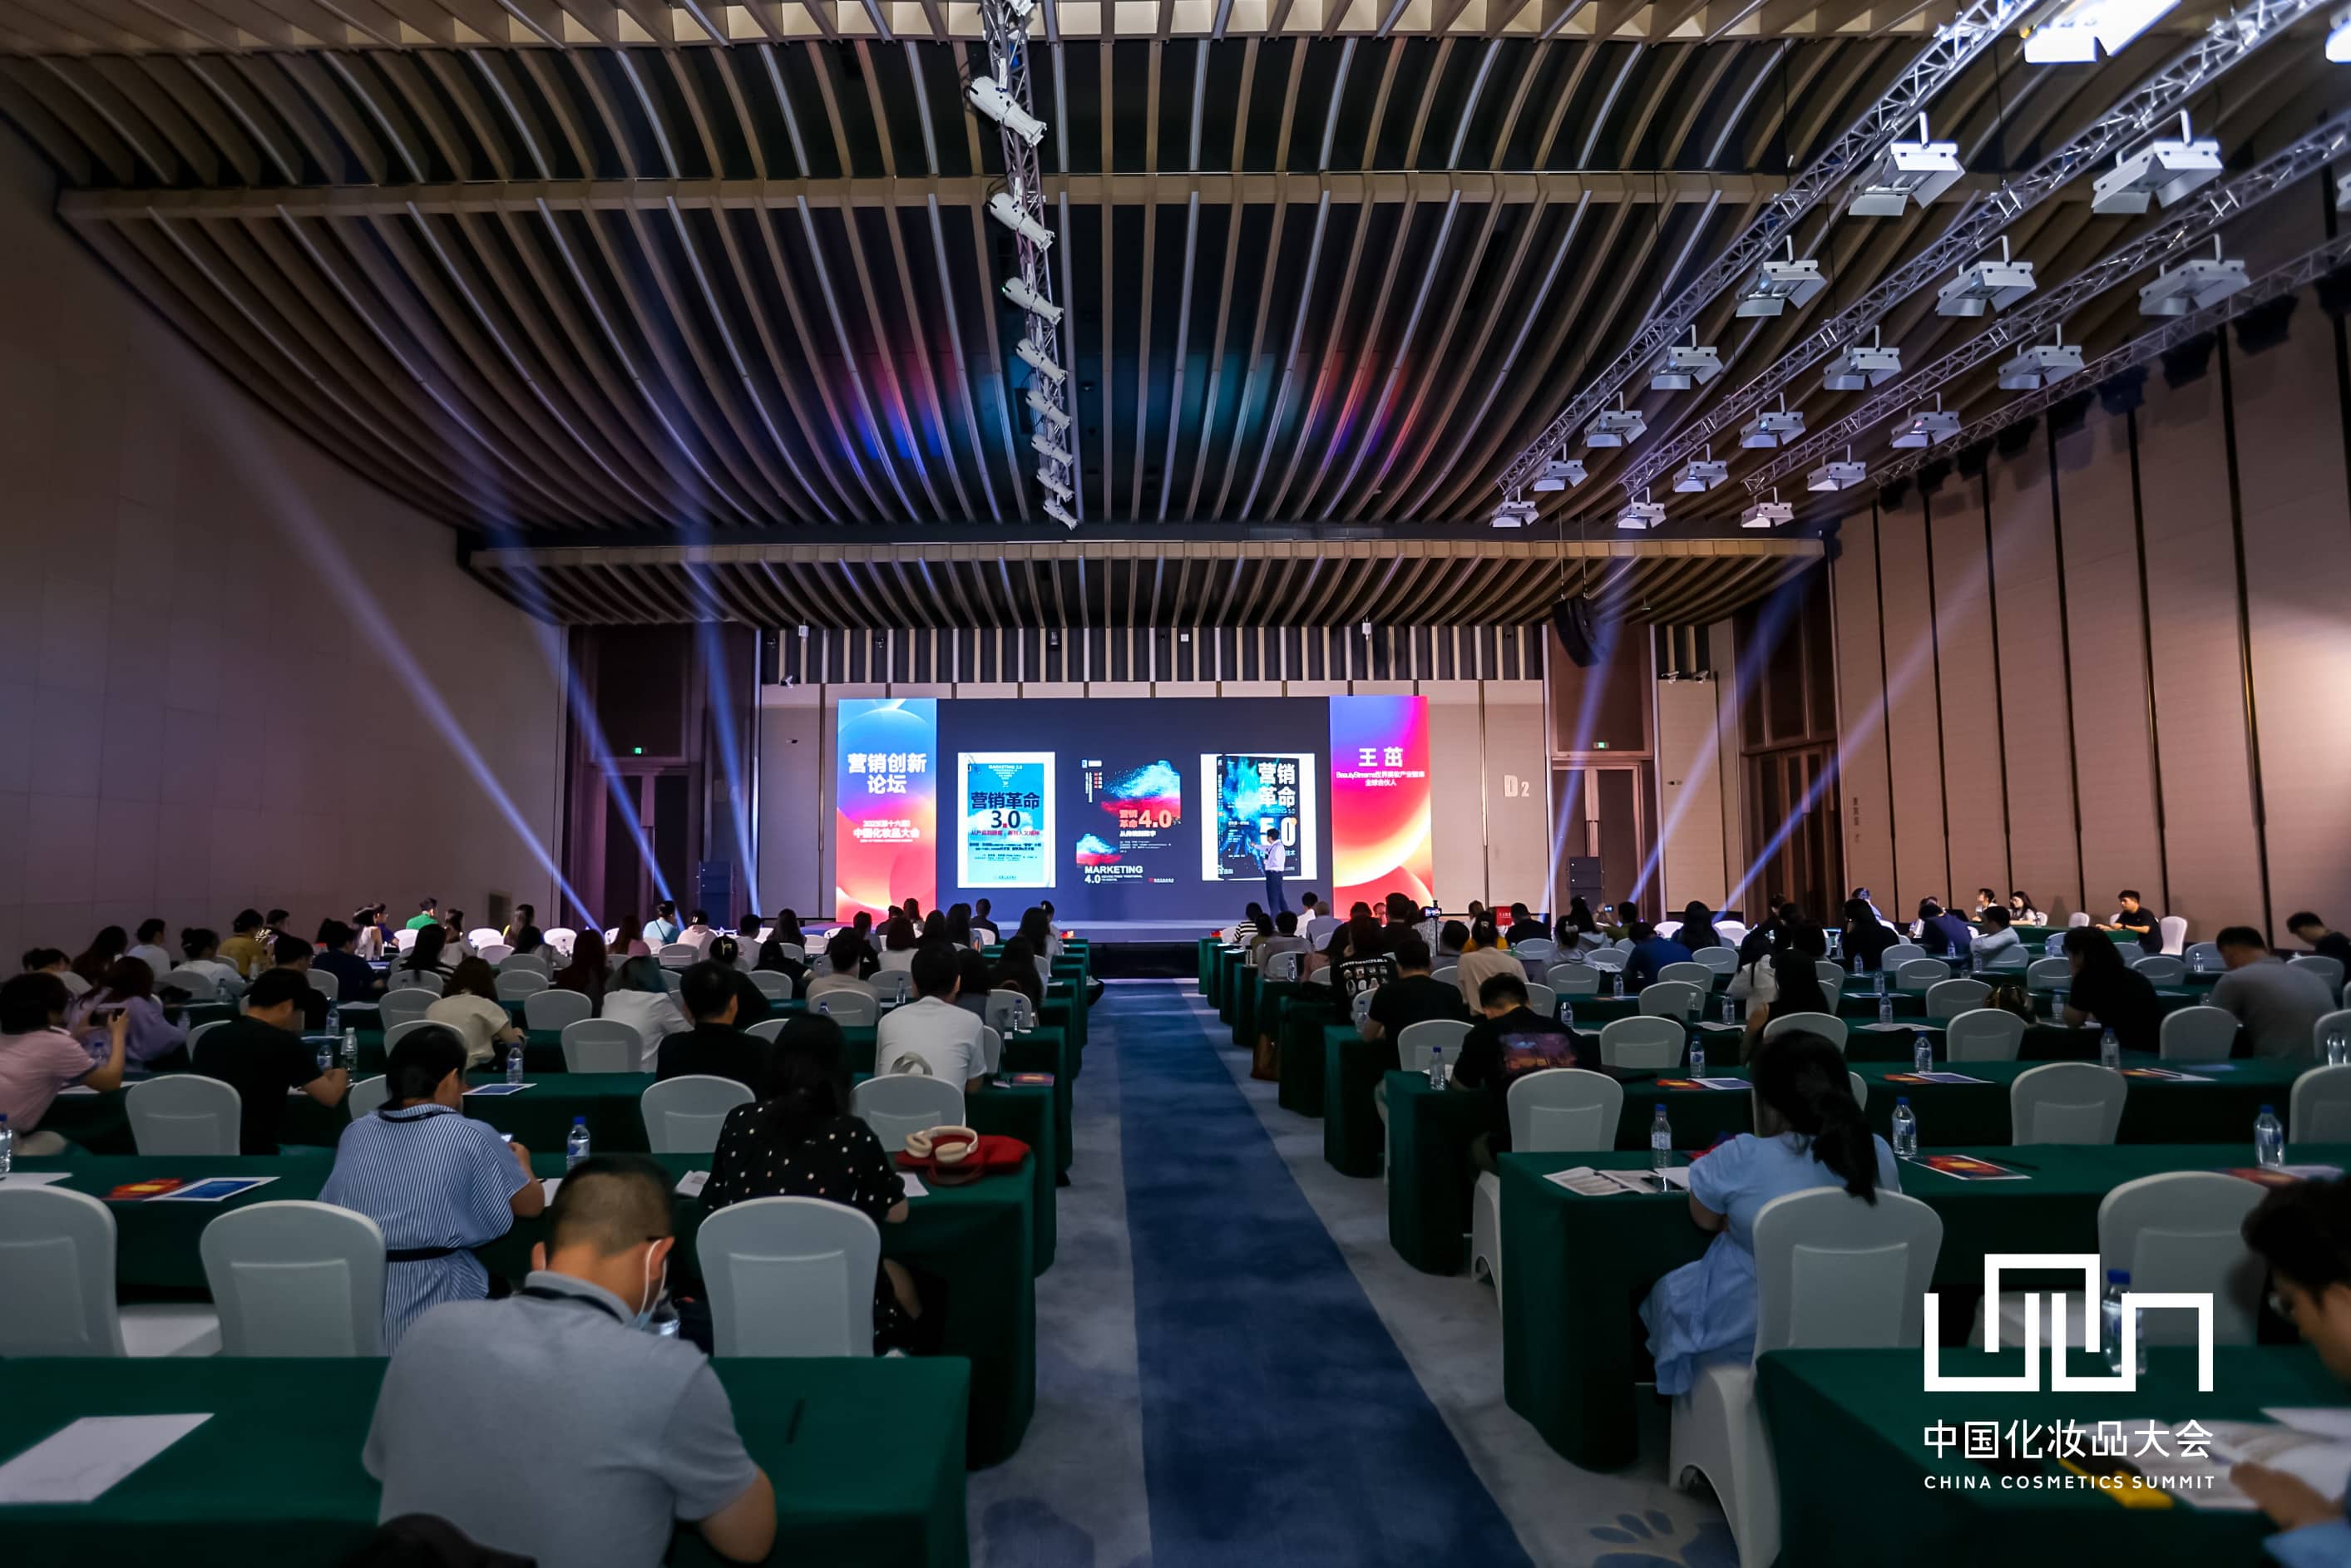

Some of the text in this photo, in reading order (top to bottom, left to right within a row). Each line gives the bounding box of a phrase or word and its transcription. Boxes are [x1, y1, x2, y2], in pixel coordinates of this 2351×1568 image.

[847, 752, 927, 773] 营销创新
[1258, 762, 1295, 784] 营销
[867, 774, 906, 794] 论坛
[971, 791, 1040, 809] 营销革命
[1258, 786, 1295, 807] 革命
[991, 810, 1020, 828] 3.0
[1138, 810, 1172, 828] 4.0
[853, 828, 920, 838] 中国化妆品大会
[1084, 865, 1143, 874] MARKETING
[1084, 875, 1100, 884] 4.0
